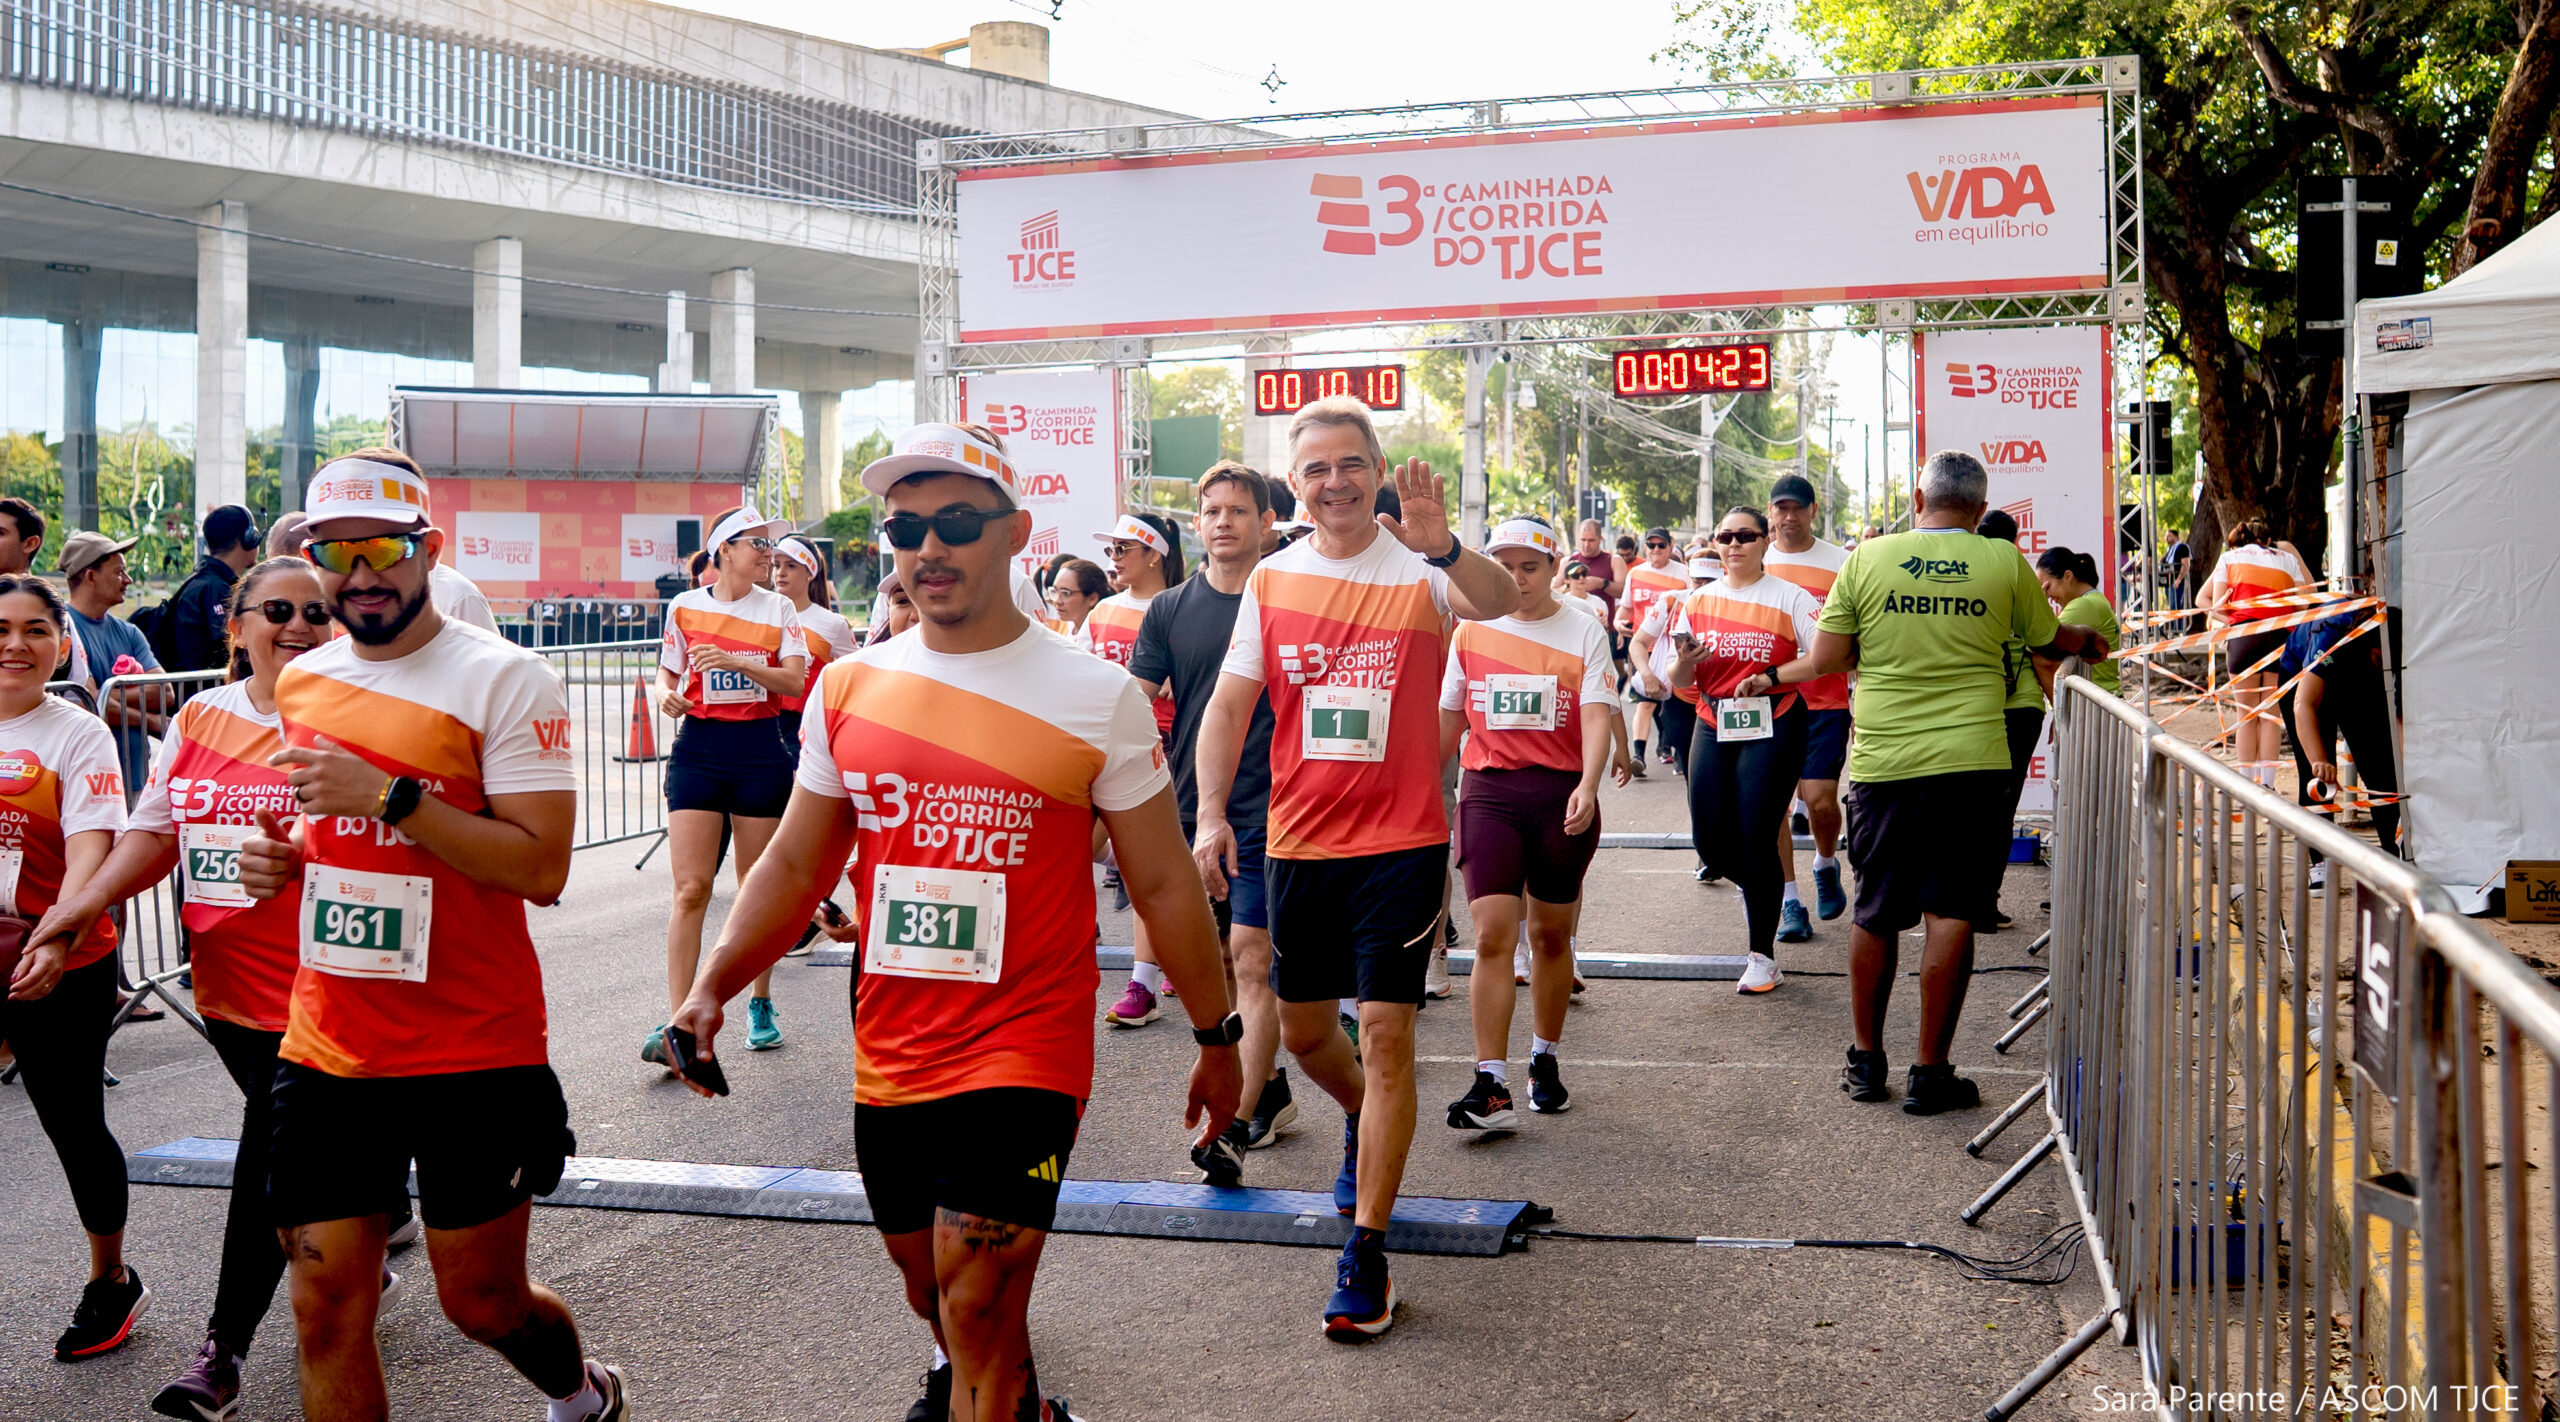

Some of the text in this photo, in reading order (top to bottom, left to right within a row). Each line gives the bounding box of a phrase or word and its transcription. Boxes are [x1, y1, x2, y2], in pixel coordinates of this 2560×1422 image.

[1938, 152, 2022, 165] PROGRAMA
[1443, 174, 1614, 203] CAMINHADA
[1906, 164, 2056, 223] VIDA
[1432, 199, 1609, 234] /CORRIDA
[1915, 220, 2049, 246] em equilíbrio
[1433, 231, 1603, 280] DO TJCE
[1007, 250, 1076, 283] TJCE
[1617, 347, 1767, 393] 00:04:23
[2006, 366, 2083, 377] CAMINHADA
[2001, 376, 2080, 390] /CORRIDA
[2001, 389, 2078, 410] DO TJCE
[1034, 406, 1098, 416] CAMINHADA
[1030, 416, 1096, 428] /CORRIDA
[1031, 428, 1095, 446] DO TJCE
[1980, 440, 2048, 465] VIDA
[345, 490, 374, 501] TJCE
[2013, 530, 2048, 554] CE
[506, 552, 532, 564] TJCE
[543, 604, 555, 617] 2
[1883, 589, 1988, 617] ÁRBITRO
[1719, 638, 1774, 649] /CORRIDA
[1723, 632, 1776, 641] CAMINHADA
[1718, 647, 1772, 663] DO TJCE
[711, 671, 754, 690] 1615
[1327, 671, 1352, 688] DO
[1499, 692, 1533, 713] 511
[1331, 710, 1343, 736] 1
[1732, 711, 1752, 728] 19
[226, 784, 295, 797] CAMINH
[922, 783, 1043, 810] CAMINHADA
[914, 799, 1034, 829] /CORRIDA
[336, 816, 368, 837] DO
[913, 823, 1029, 867] DO TJCE
[195, 850, 242, 882] 256
[878, 882, 888, 905] 3KM
[324, 903, 386, 947] 961
[898, 903, 961, 946] 381
